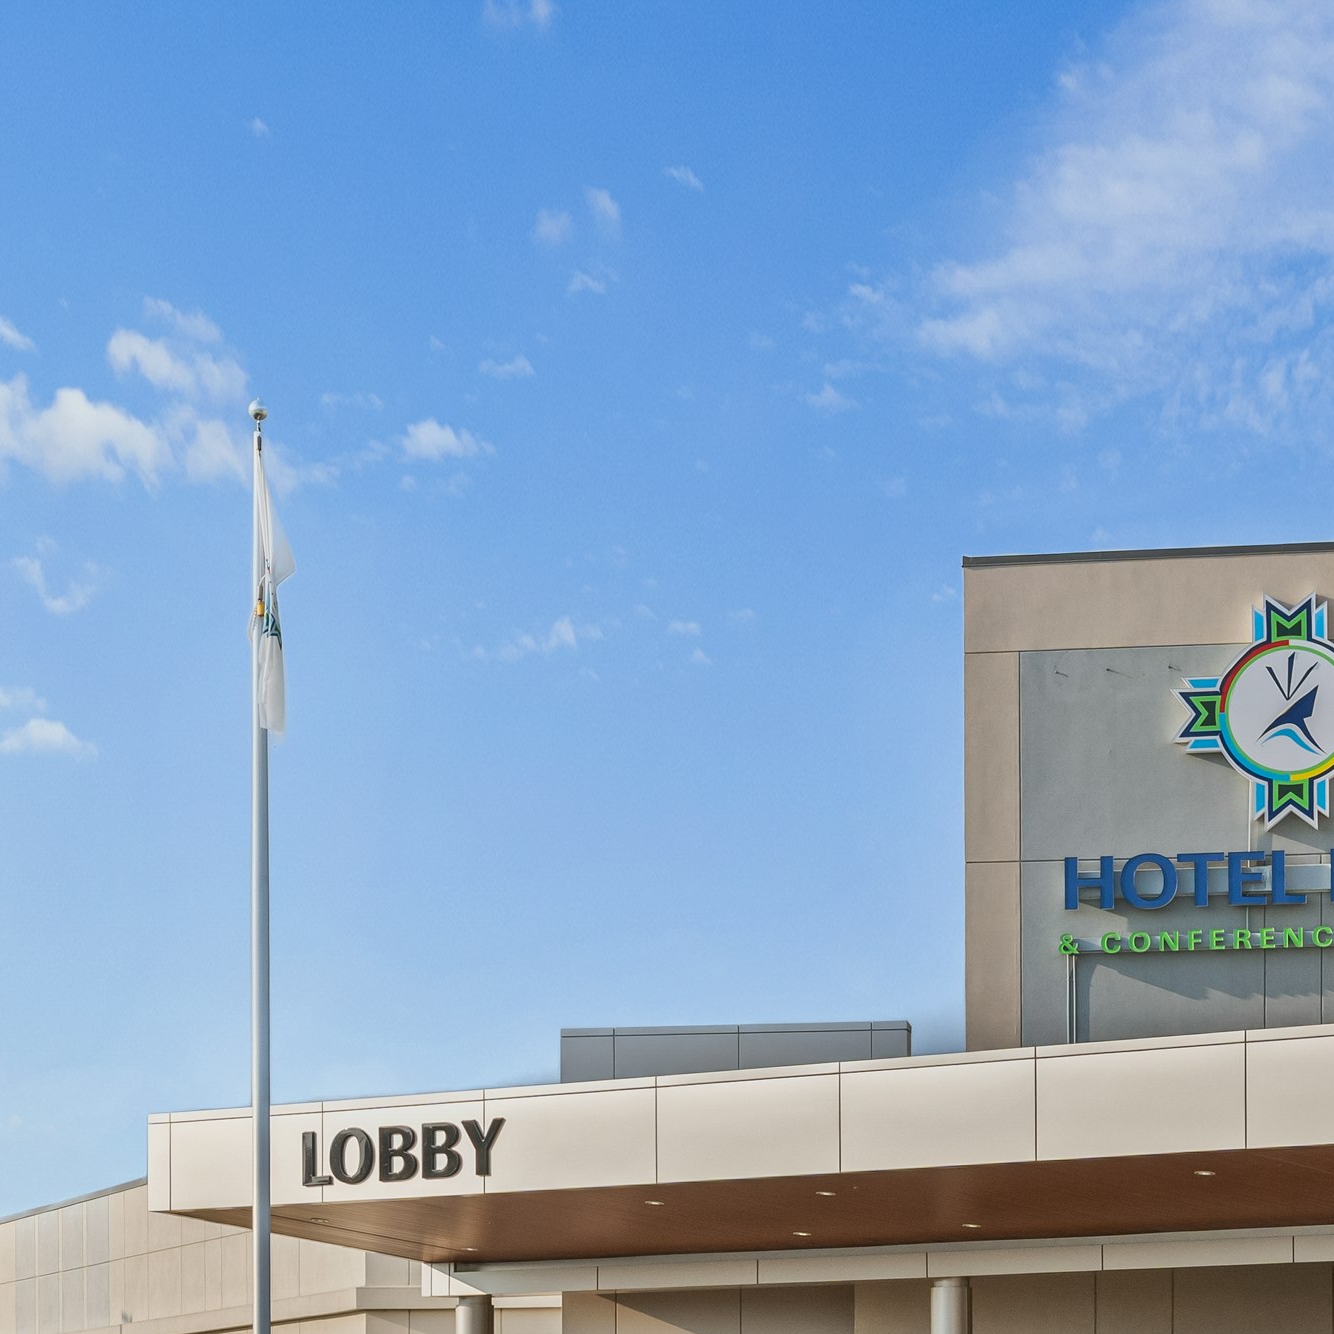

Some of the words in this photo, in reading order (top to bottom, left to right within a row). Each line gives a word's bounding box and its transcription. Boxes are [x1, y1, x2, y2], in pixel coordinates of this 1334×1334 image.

[1064, 849, 1308, 910] HOTEL
[1058, 933, 1080, 955] &
[301, 1117, 506, 1187] LOBBY
